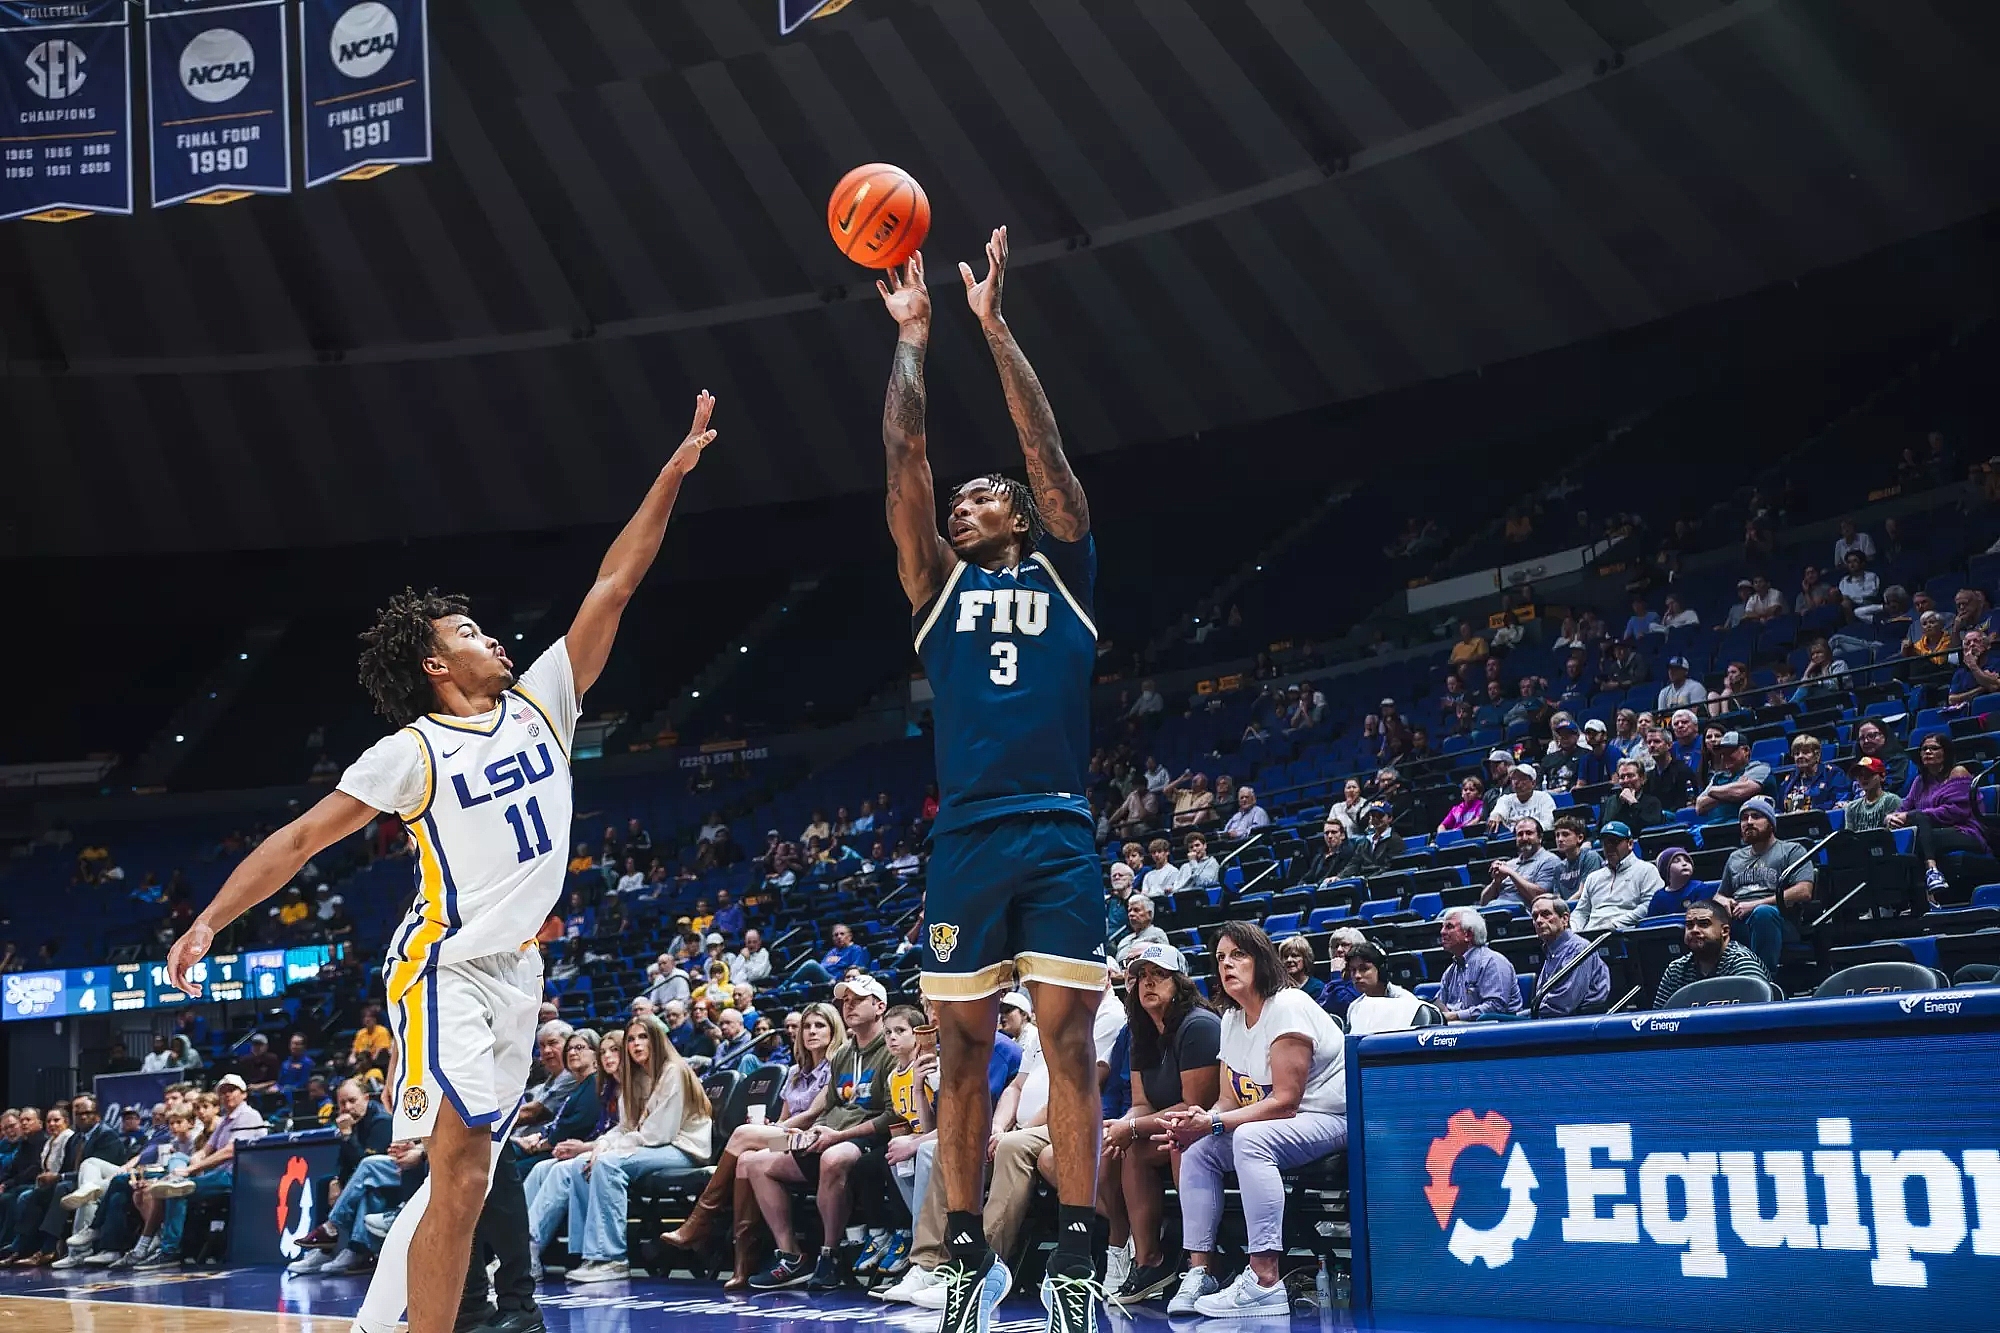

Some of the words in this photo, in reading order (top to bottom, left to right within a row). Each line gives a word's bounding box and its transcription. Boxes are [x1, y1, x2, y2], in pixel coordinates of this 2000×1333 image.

[23, 5, 89, 18] VOLLEYBALL
[339, 32, 397, 62] NCAA
[25, 39, 87, 99] SEC
[188, 61, 251, 86] NCAA
[20, 108, 96, 123] CHAMPIONS
[328, 106, 366, 128] FINAL
[369, 97, 404, 118] FOUR
[177, 131, 217, 149] FINAL
[222, 126, 260, 143] FOUR
[342, 120, 390, 150] 1991
[190, 146, 248, 175] 1990
[956, 589, 1050, 636] FIU
[989, 641, 1018, 686] 3
[451, 742, 554, 809] LSU
[504, 795, 552, 863] 11
[79, 988, 96, 1012] 4
[1924, 1001, 1963, 1014] Energy
[1650, 1020, 1681, 1032] Energy
[1433, 1036, 1458, 1047] Energy
